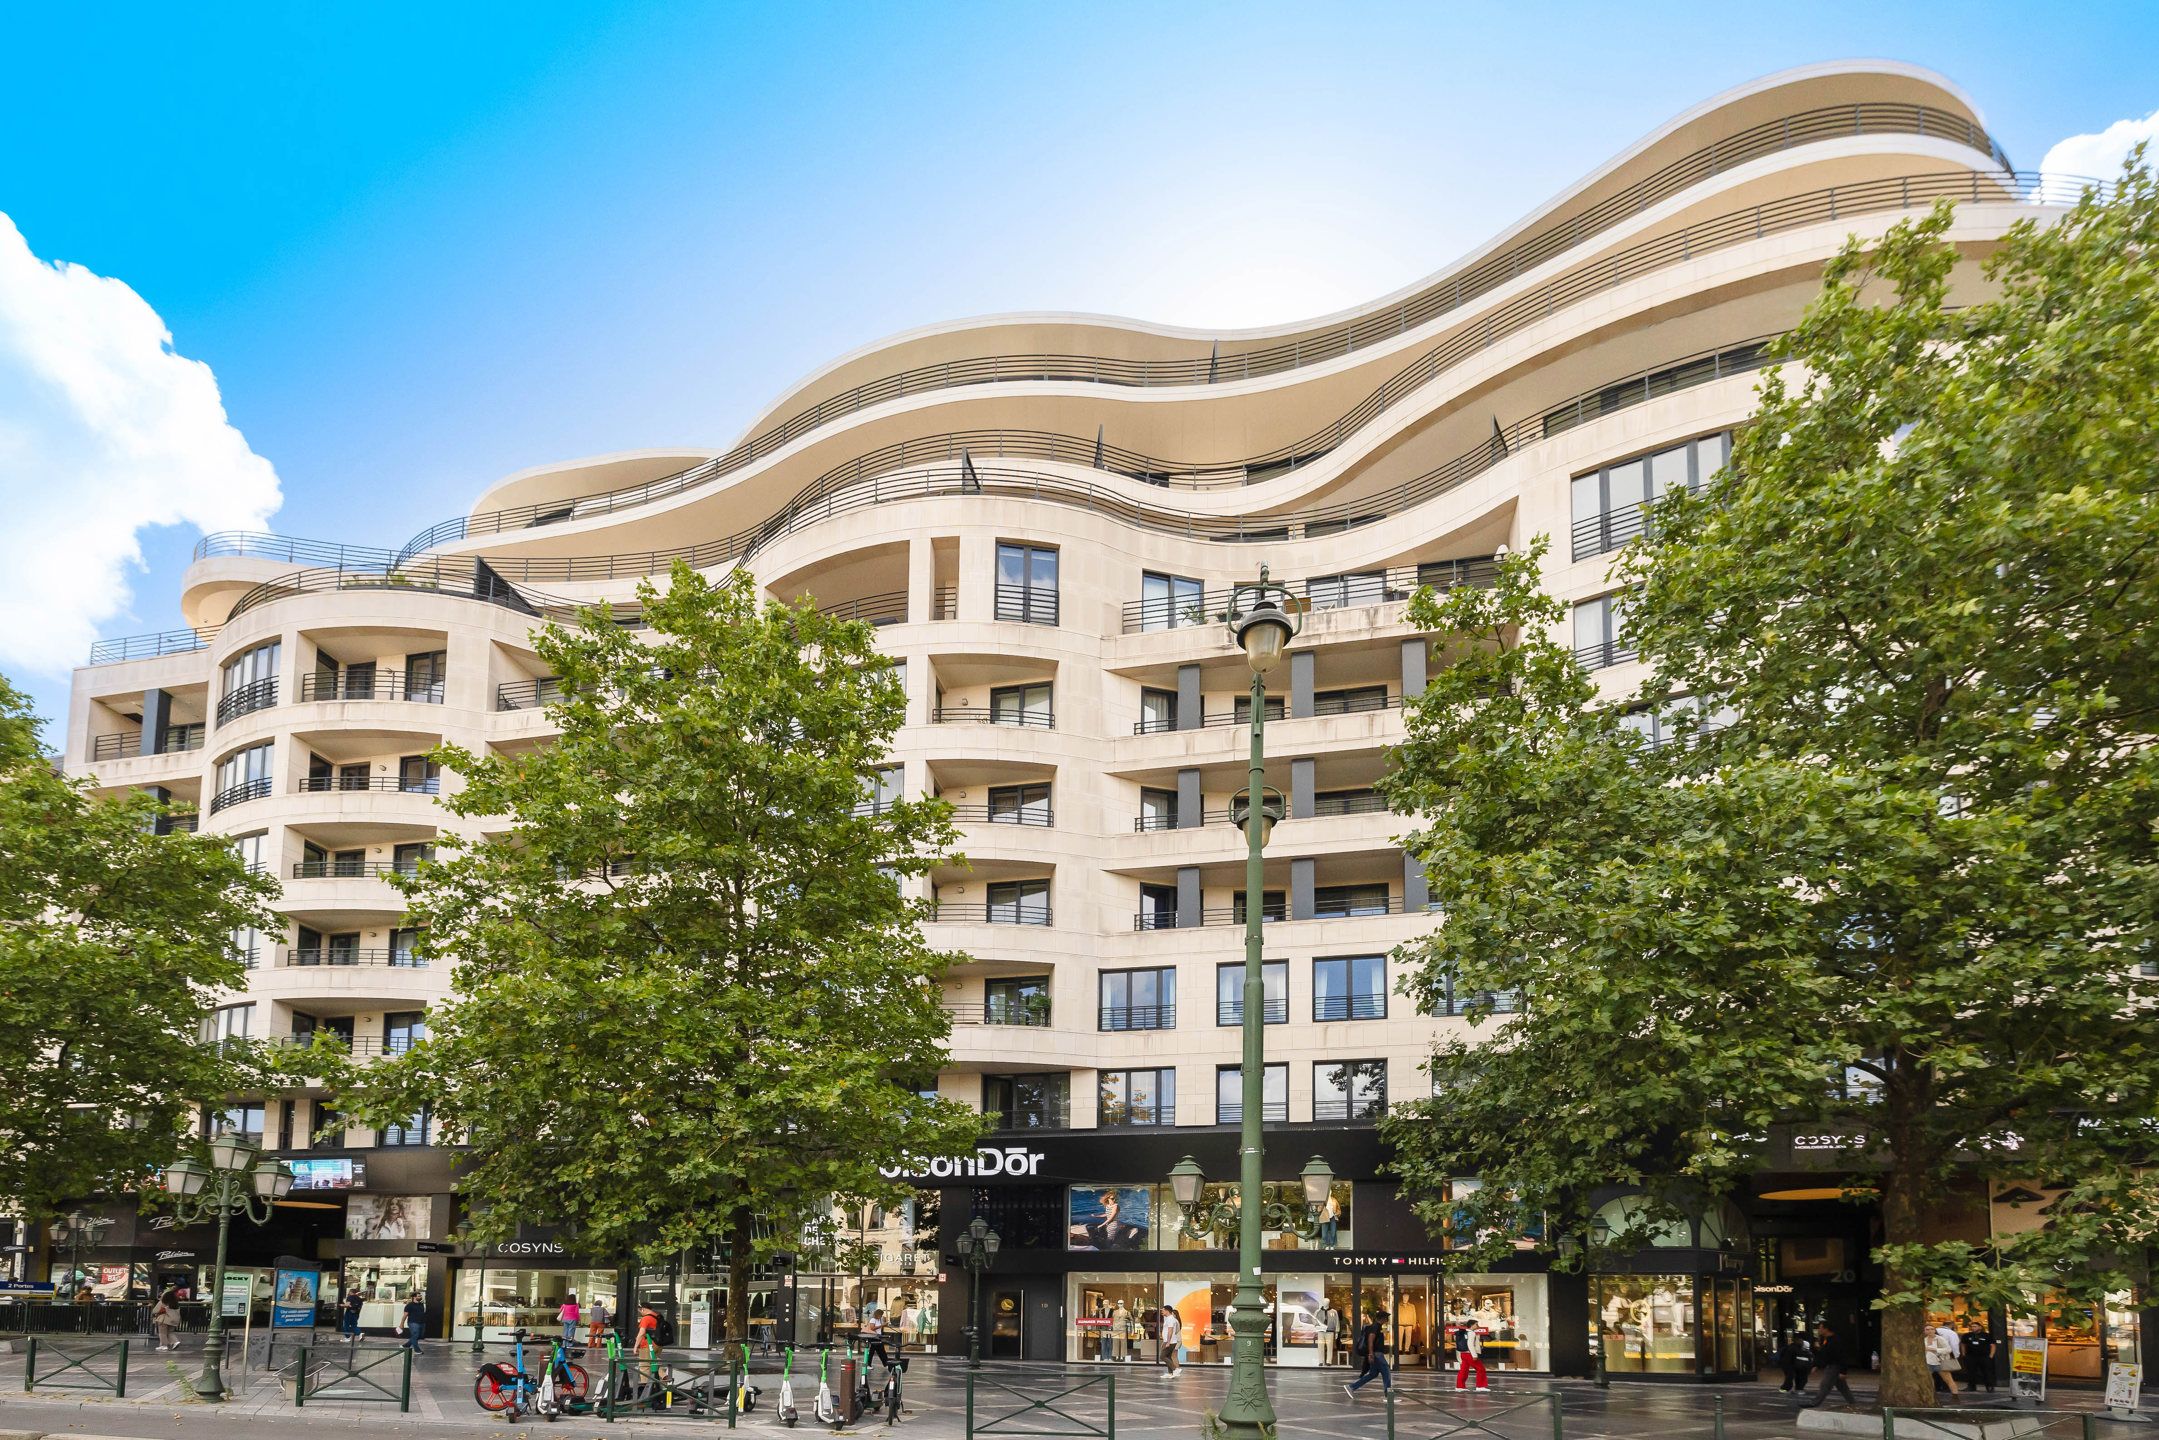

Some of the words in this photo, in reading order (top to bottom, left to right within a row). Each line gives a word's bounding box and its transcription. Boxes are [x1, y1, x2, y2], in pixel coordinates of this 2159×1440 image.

[1794, 1135, 1866, 1145] COSYS
[498, 1243, 564, 1253] COSYNS
[1333, 1257, 1388, 1266] TOMMY
[1408, 1257, 1462, 1266] HILFI
